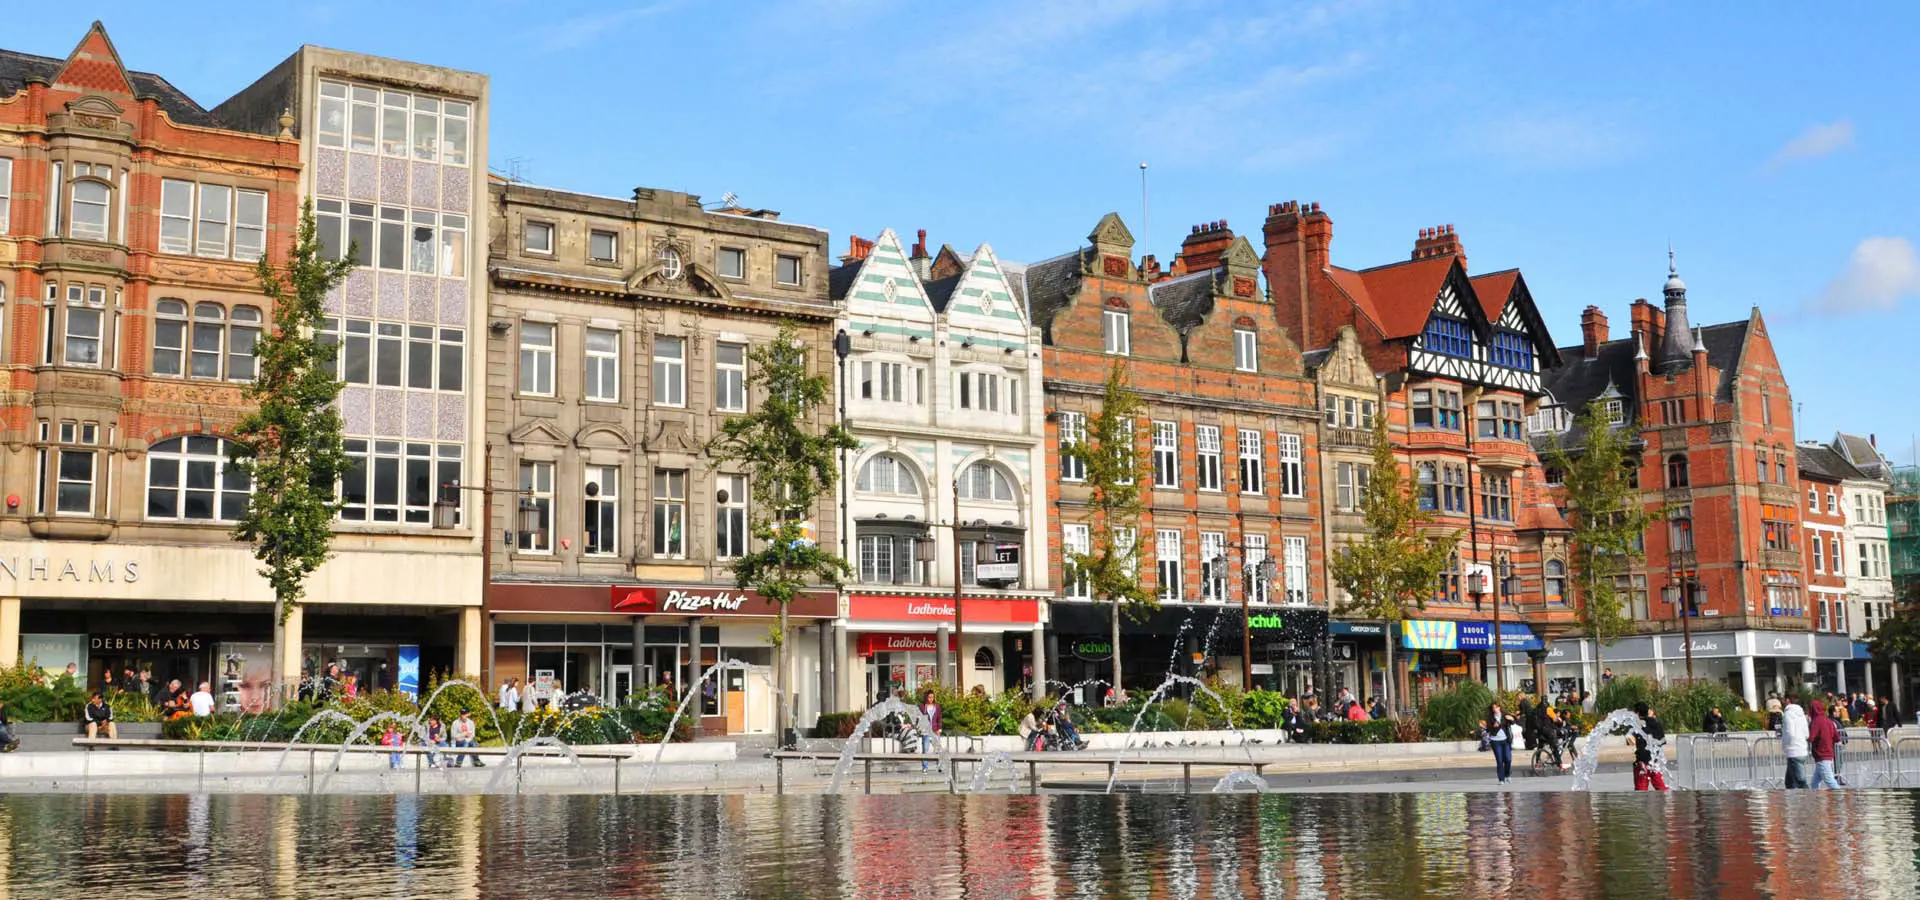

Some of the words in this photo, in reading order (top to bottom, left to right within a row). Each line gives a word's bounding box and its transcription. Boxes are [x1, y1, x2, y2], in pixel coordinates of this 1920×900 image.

[995, 552, 1011, 562] LET
[663, 590, 712, 611] Pizza
[712, 591, 748, 610] Hut
[92, 638, 201, 650] DEBENHAMS
[887, 636, 937, 648] Ladbrokes
[1461, 637, 1487, 645] STREET
[1079, 642, 1112, 653] schuh
